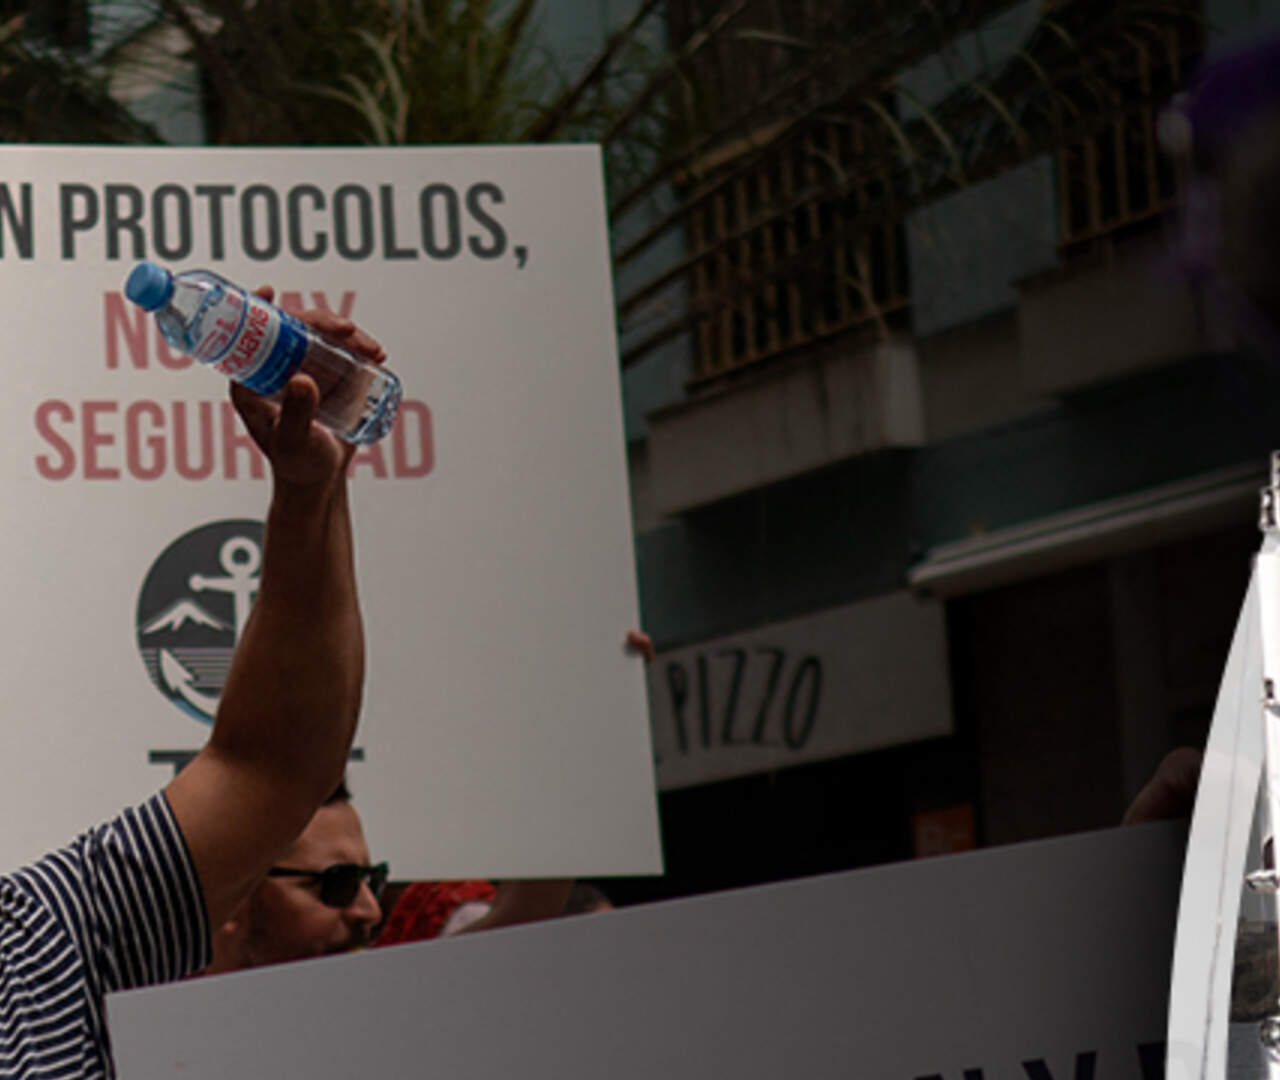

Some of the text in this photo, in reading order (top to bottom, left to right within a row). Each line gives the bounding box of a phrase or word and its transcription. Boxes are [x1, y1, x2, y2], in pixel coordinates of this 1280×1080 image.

[58, 181, 528, 269] PROTOCOLOS,
[34, 399, 436, 481] SEGURAD
[666, 645, 823, 755] PIZZO
